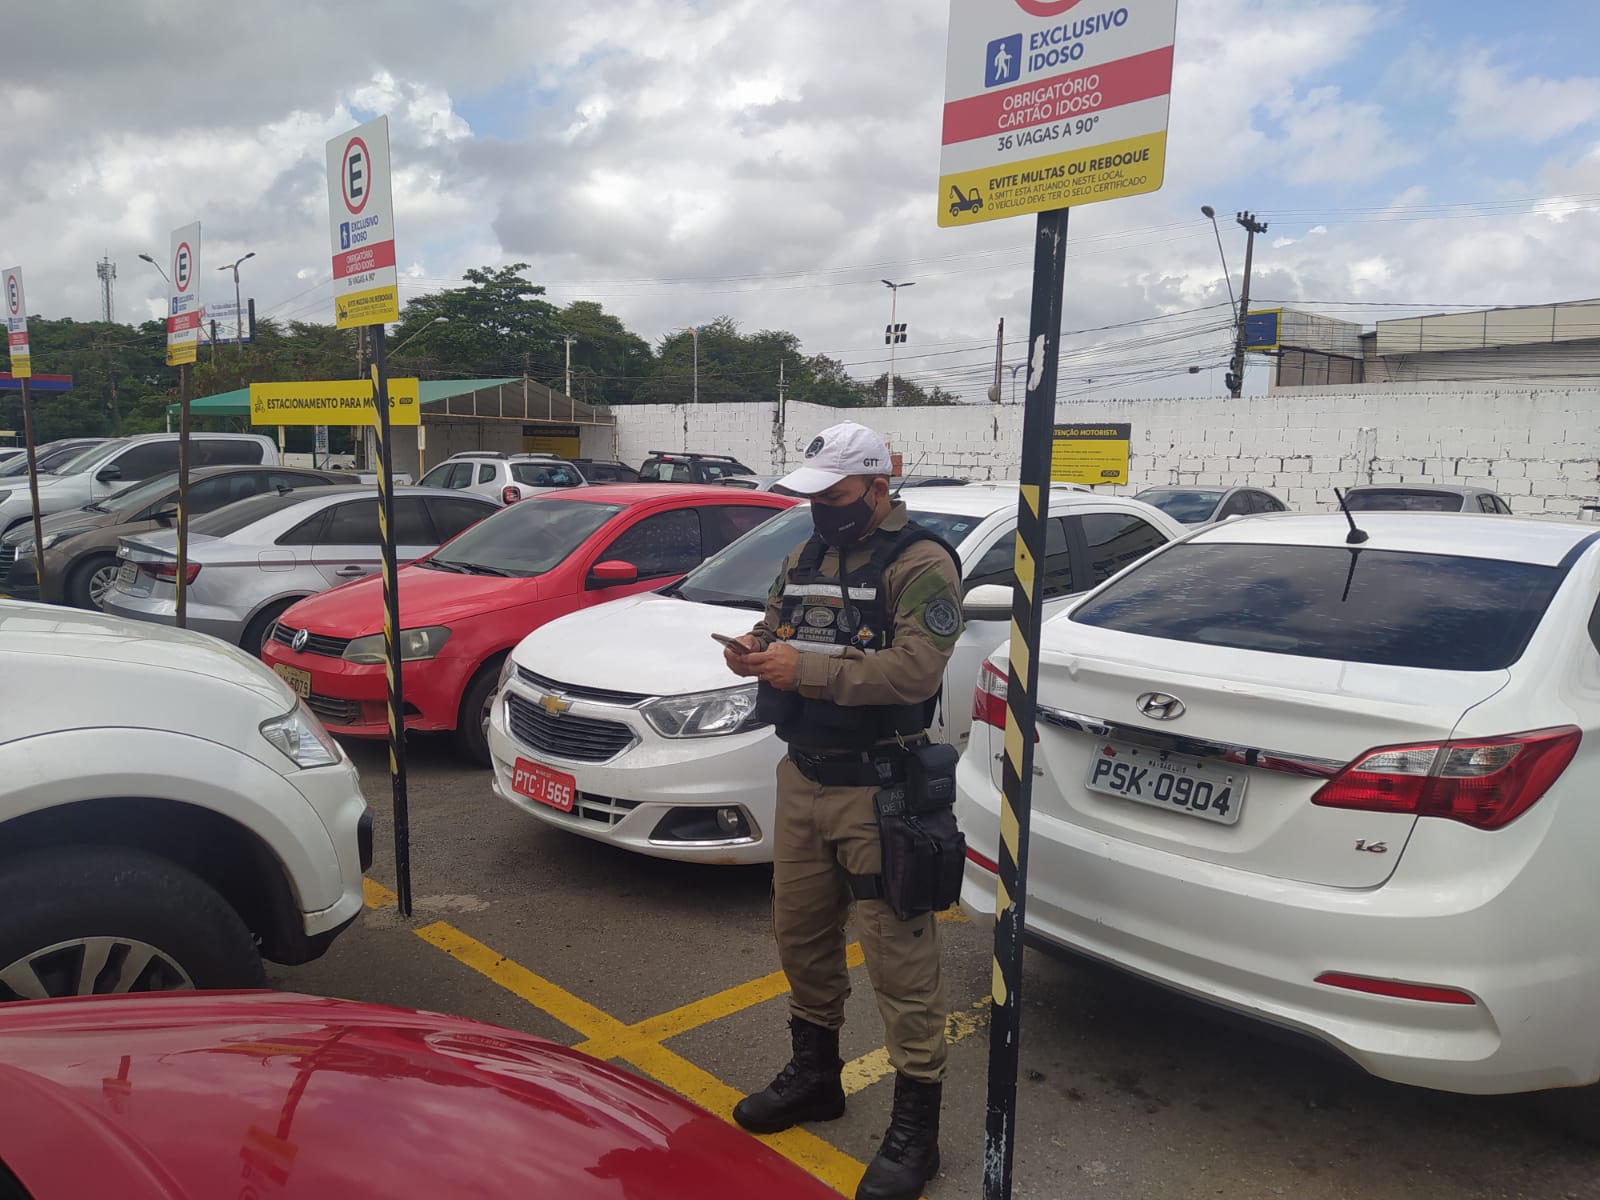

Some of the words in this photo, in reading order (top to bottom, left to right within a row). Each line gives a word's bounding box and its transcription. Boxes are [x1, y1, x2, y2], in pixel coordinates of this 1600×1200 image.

[1030, 8, 1129, 51] EXCLUSIVO
[1028, 42, 1084, 72] IDOSO
[1002, 74, 1100, 111] OBRIGATÓRIO
[998, 102, 1053, 129] CARTÃO
[1055, 92, 1102, 116] IDOSO
[997, 135, 1013, 151] 36
[1016, 124, 1060, 147] VAGAS
[1062, 122, 1072, 138] A
[348, 152, 363, 199] E
[988, 193, 993, 201] A
[1033, 179, 1070, 193] ATUANDO
[1071, 174, 1096, 187] NESTE
[1098, 169, 1125, 182] LOCAL
[989, 174, 1018, 190] EVITE
[1020, 165, 1065, 185] MULTAS
[1067, 160, 1086, 175] OU
[1089, 148, 1150, 171] REBOQUE
[987, 202, 994, 211] O
[1027, 193, 1046, 204] DEVE
[1048, 190, 1062, 201] TER
[1063, 189, 1070, 198] O
[1071, 185, 1092, 197] SELO
[1093, 175, 1147, 193] CERTIFICADO
[179, 252, 187, 282] E
[267, 398, 338, 410] ESTACIONAMENTO
[339, 397, 361, 409] PARA
[863, 458, 879, 467] GTT
